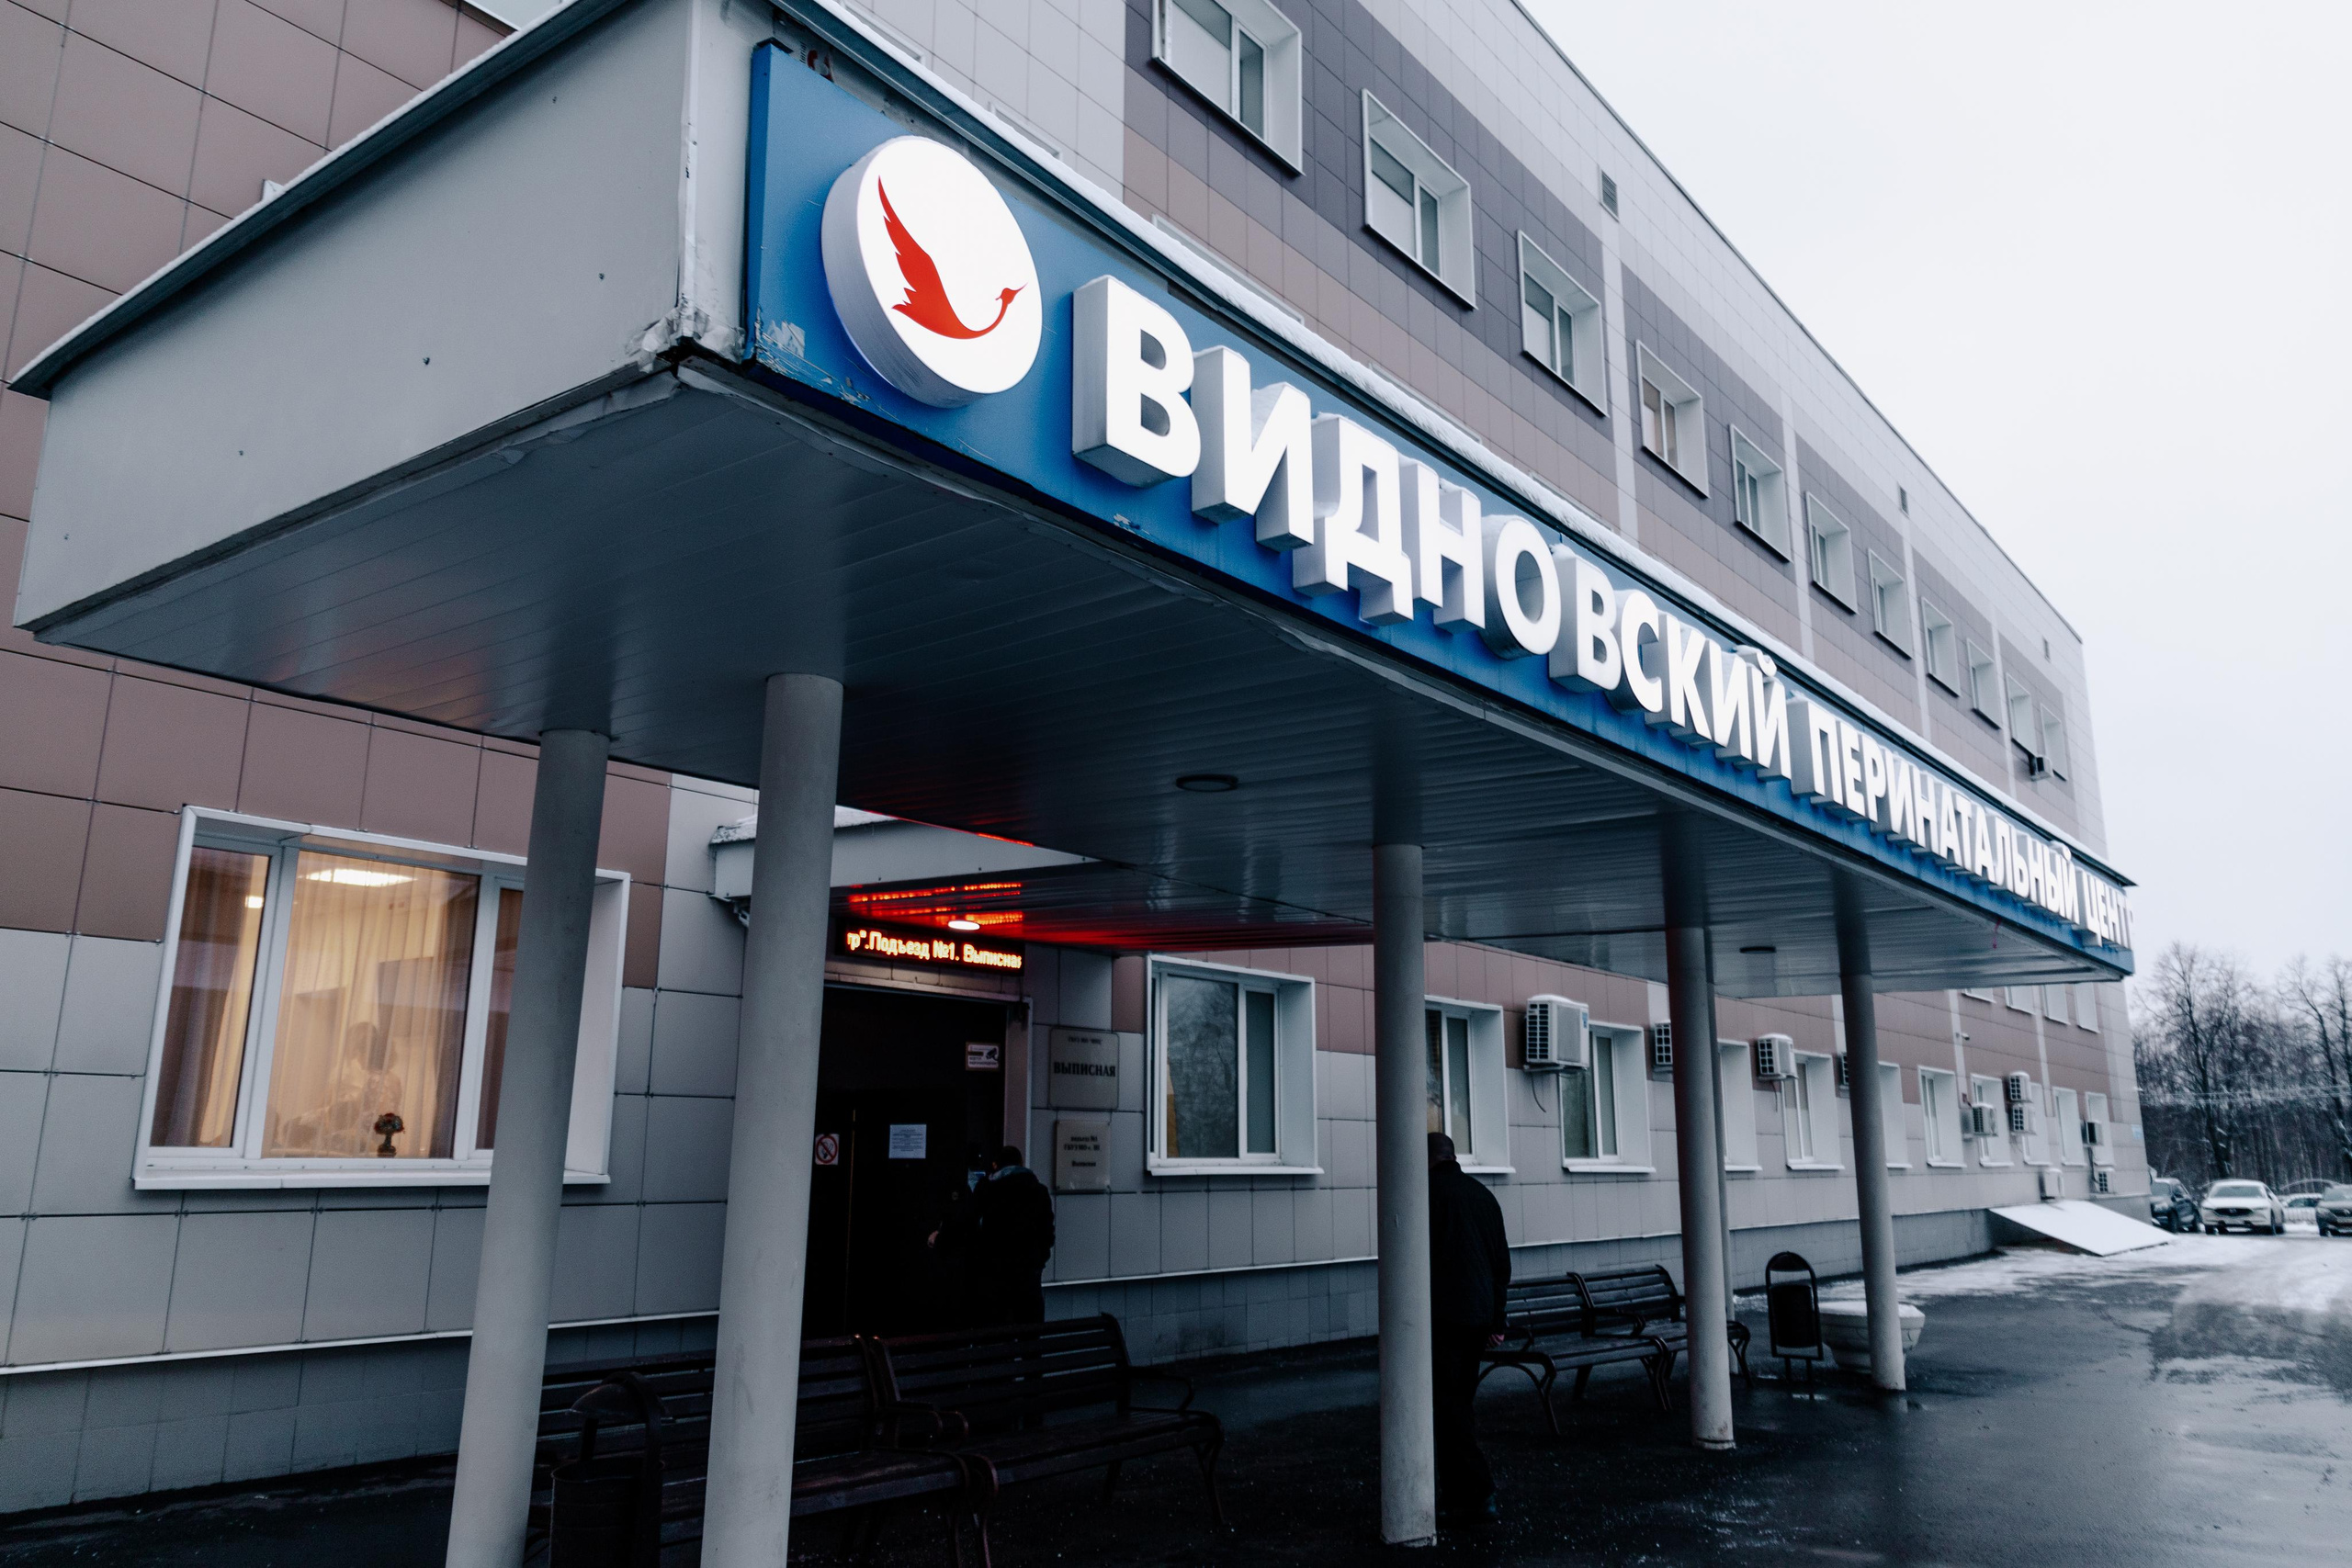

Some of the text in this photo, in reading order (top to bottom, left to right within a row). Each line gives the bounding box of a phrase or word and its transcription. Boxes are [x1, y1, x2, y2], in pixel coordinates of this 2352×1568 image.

[1072, 276, 1792, 781] ВИДНОВСКИЙ
[1792, 697, 2079, 925] ПЕРИНАТАЛЬНЫЙ
[1054, 1062, 1115, 1077] ВЫПИСНАЯ
